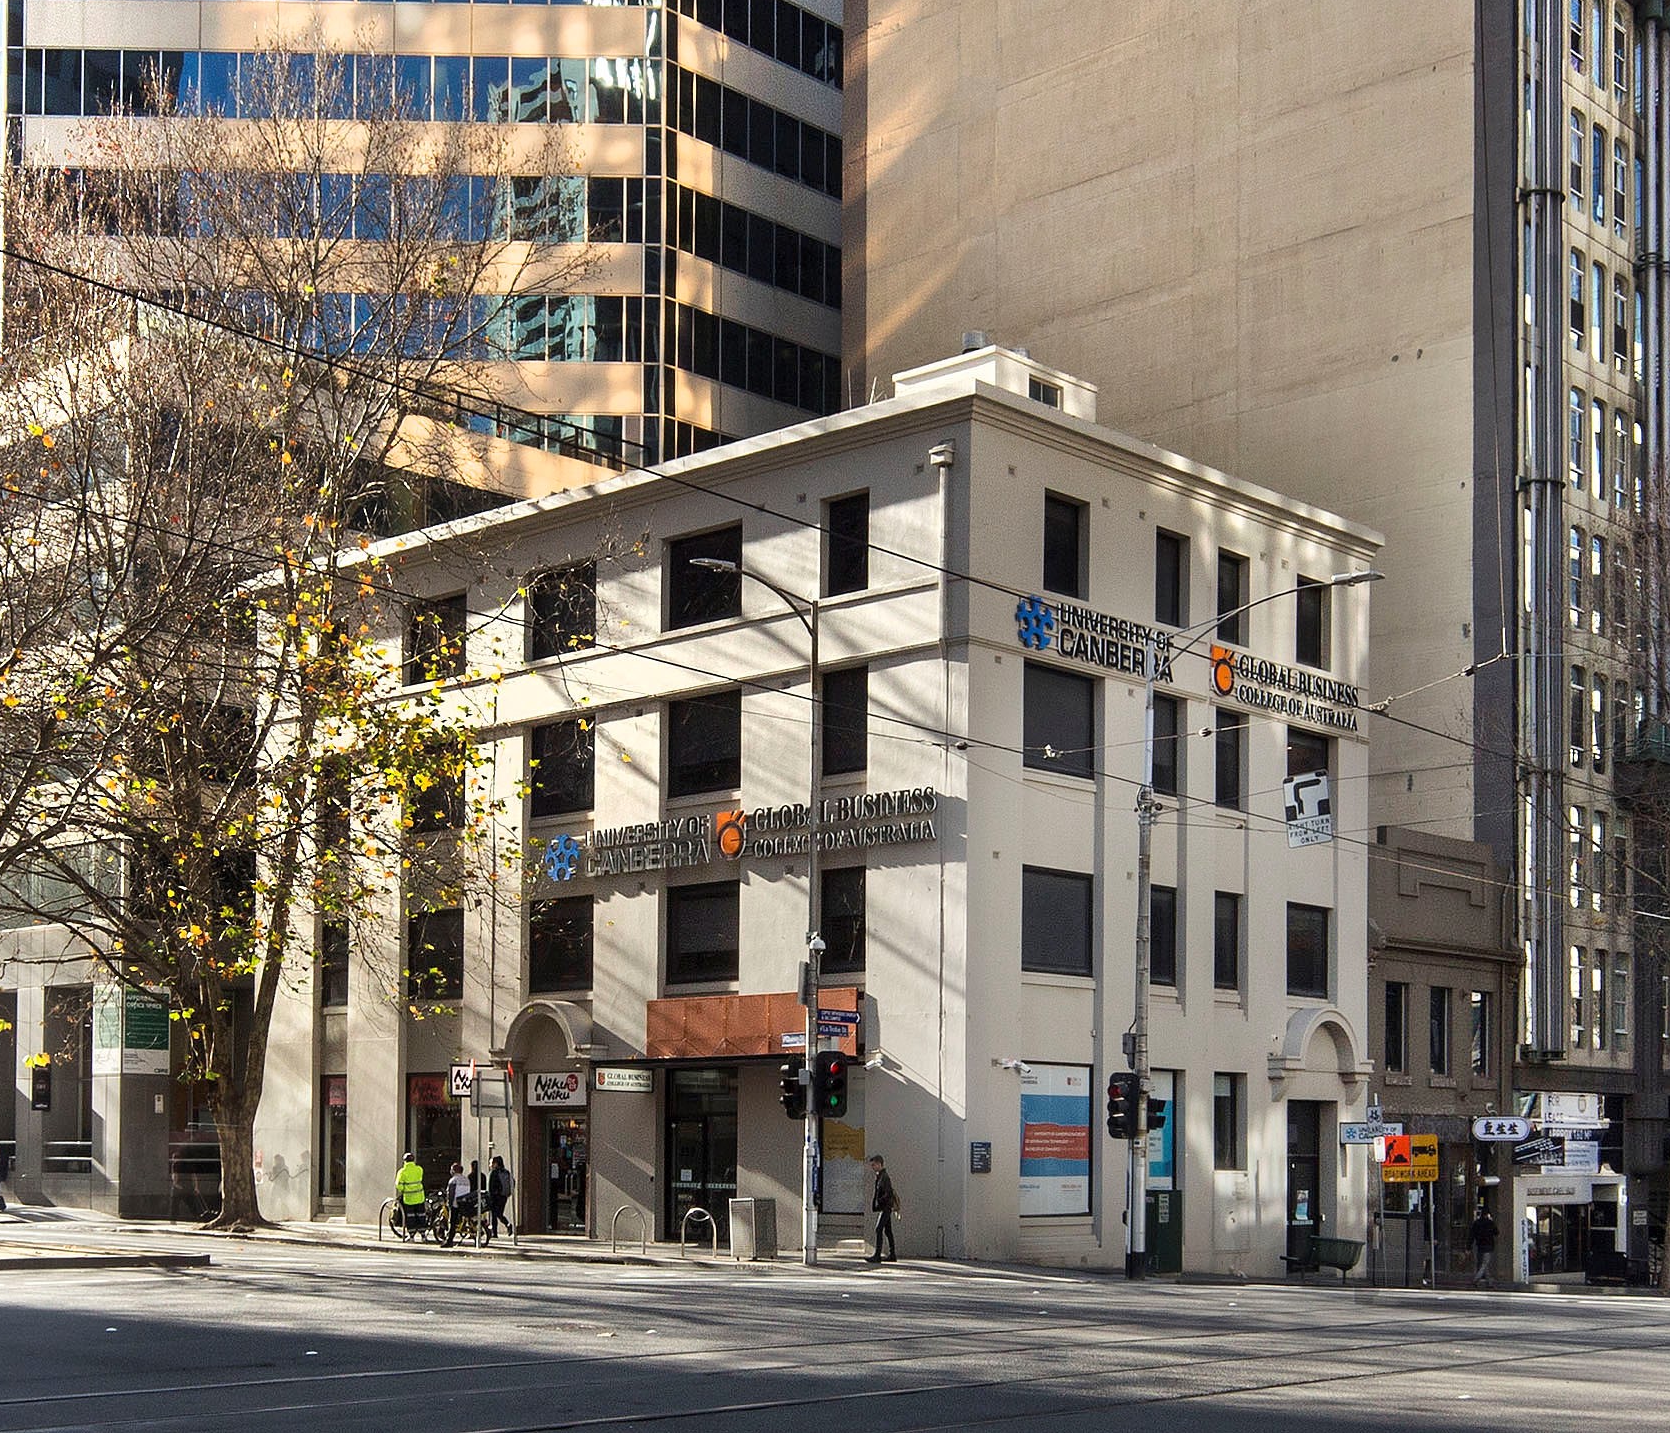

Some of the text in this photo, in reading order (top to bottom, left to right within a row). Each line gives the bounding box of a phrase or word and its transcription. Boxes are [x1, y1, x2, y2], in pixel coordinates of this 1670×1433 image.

[1056, 602, 1174, 652] UNIVERSITY OF
[1238, 654, 1359, 707] GLOBAL BUSINESS
[1237, 684, 1358, 731] COLLEGE OF AUSTRALIA
[837, 786, 938, 823] BUSINESS
[584, 814, 711, 848] UNIVERSITY OF
[824, 830, 846, 851] OF
[847, 819, 937, 847] AUSTRALIA
[1311, 817, 1330, 827] TURN
[1300, 836, 1319, 844] ONLY
[585, 838, 710, 878] CANBERRA
[534, 1074, 569, 1092] Niku
[541, 1089, 570, 1101] Niku
